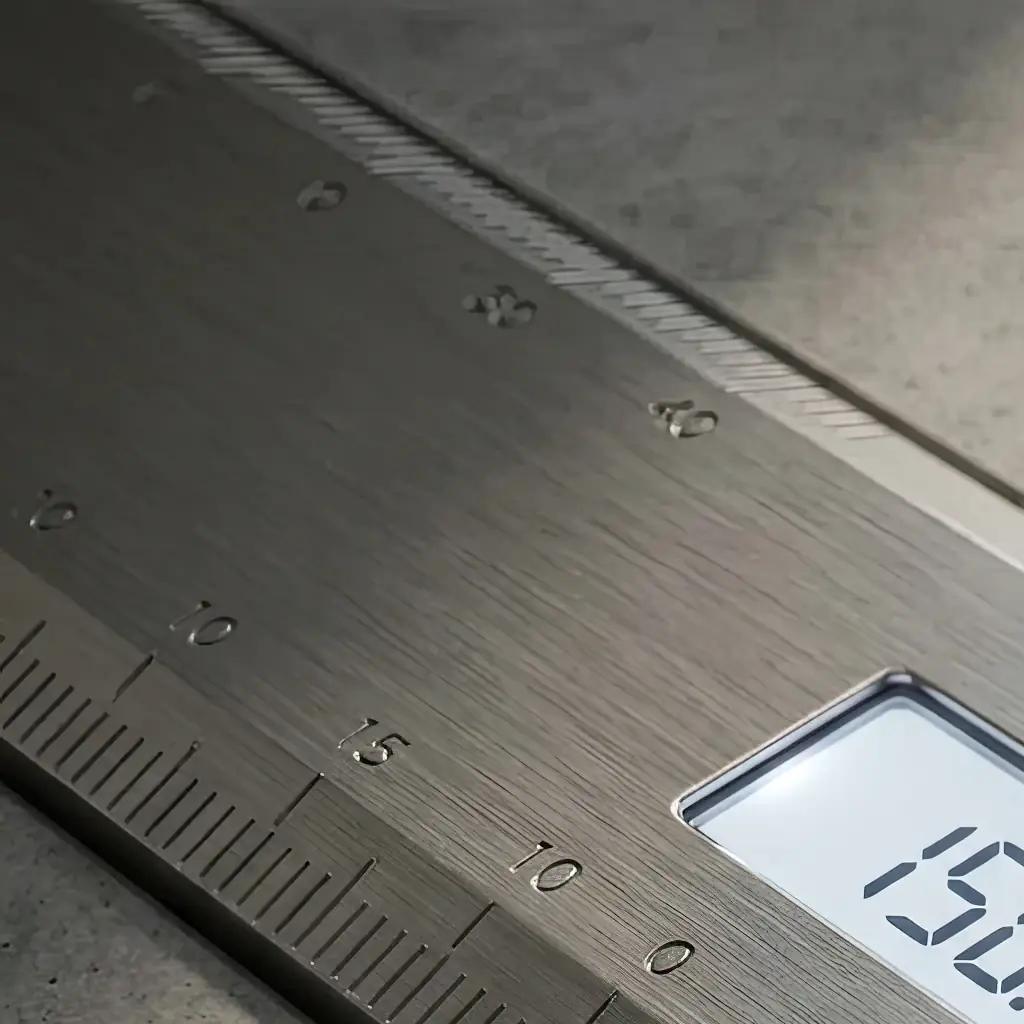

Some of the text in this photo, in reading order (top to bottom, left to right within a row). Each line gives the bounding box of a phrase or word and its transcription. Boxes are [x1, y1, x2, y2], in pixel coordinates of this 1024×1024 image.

[168, 600, 238, 646] 10
[337, 717, 411, 767] 15
[508, 839, 584, 892] 10
[643, 938, 697, 975] 0
